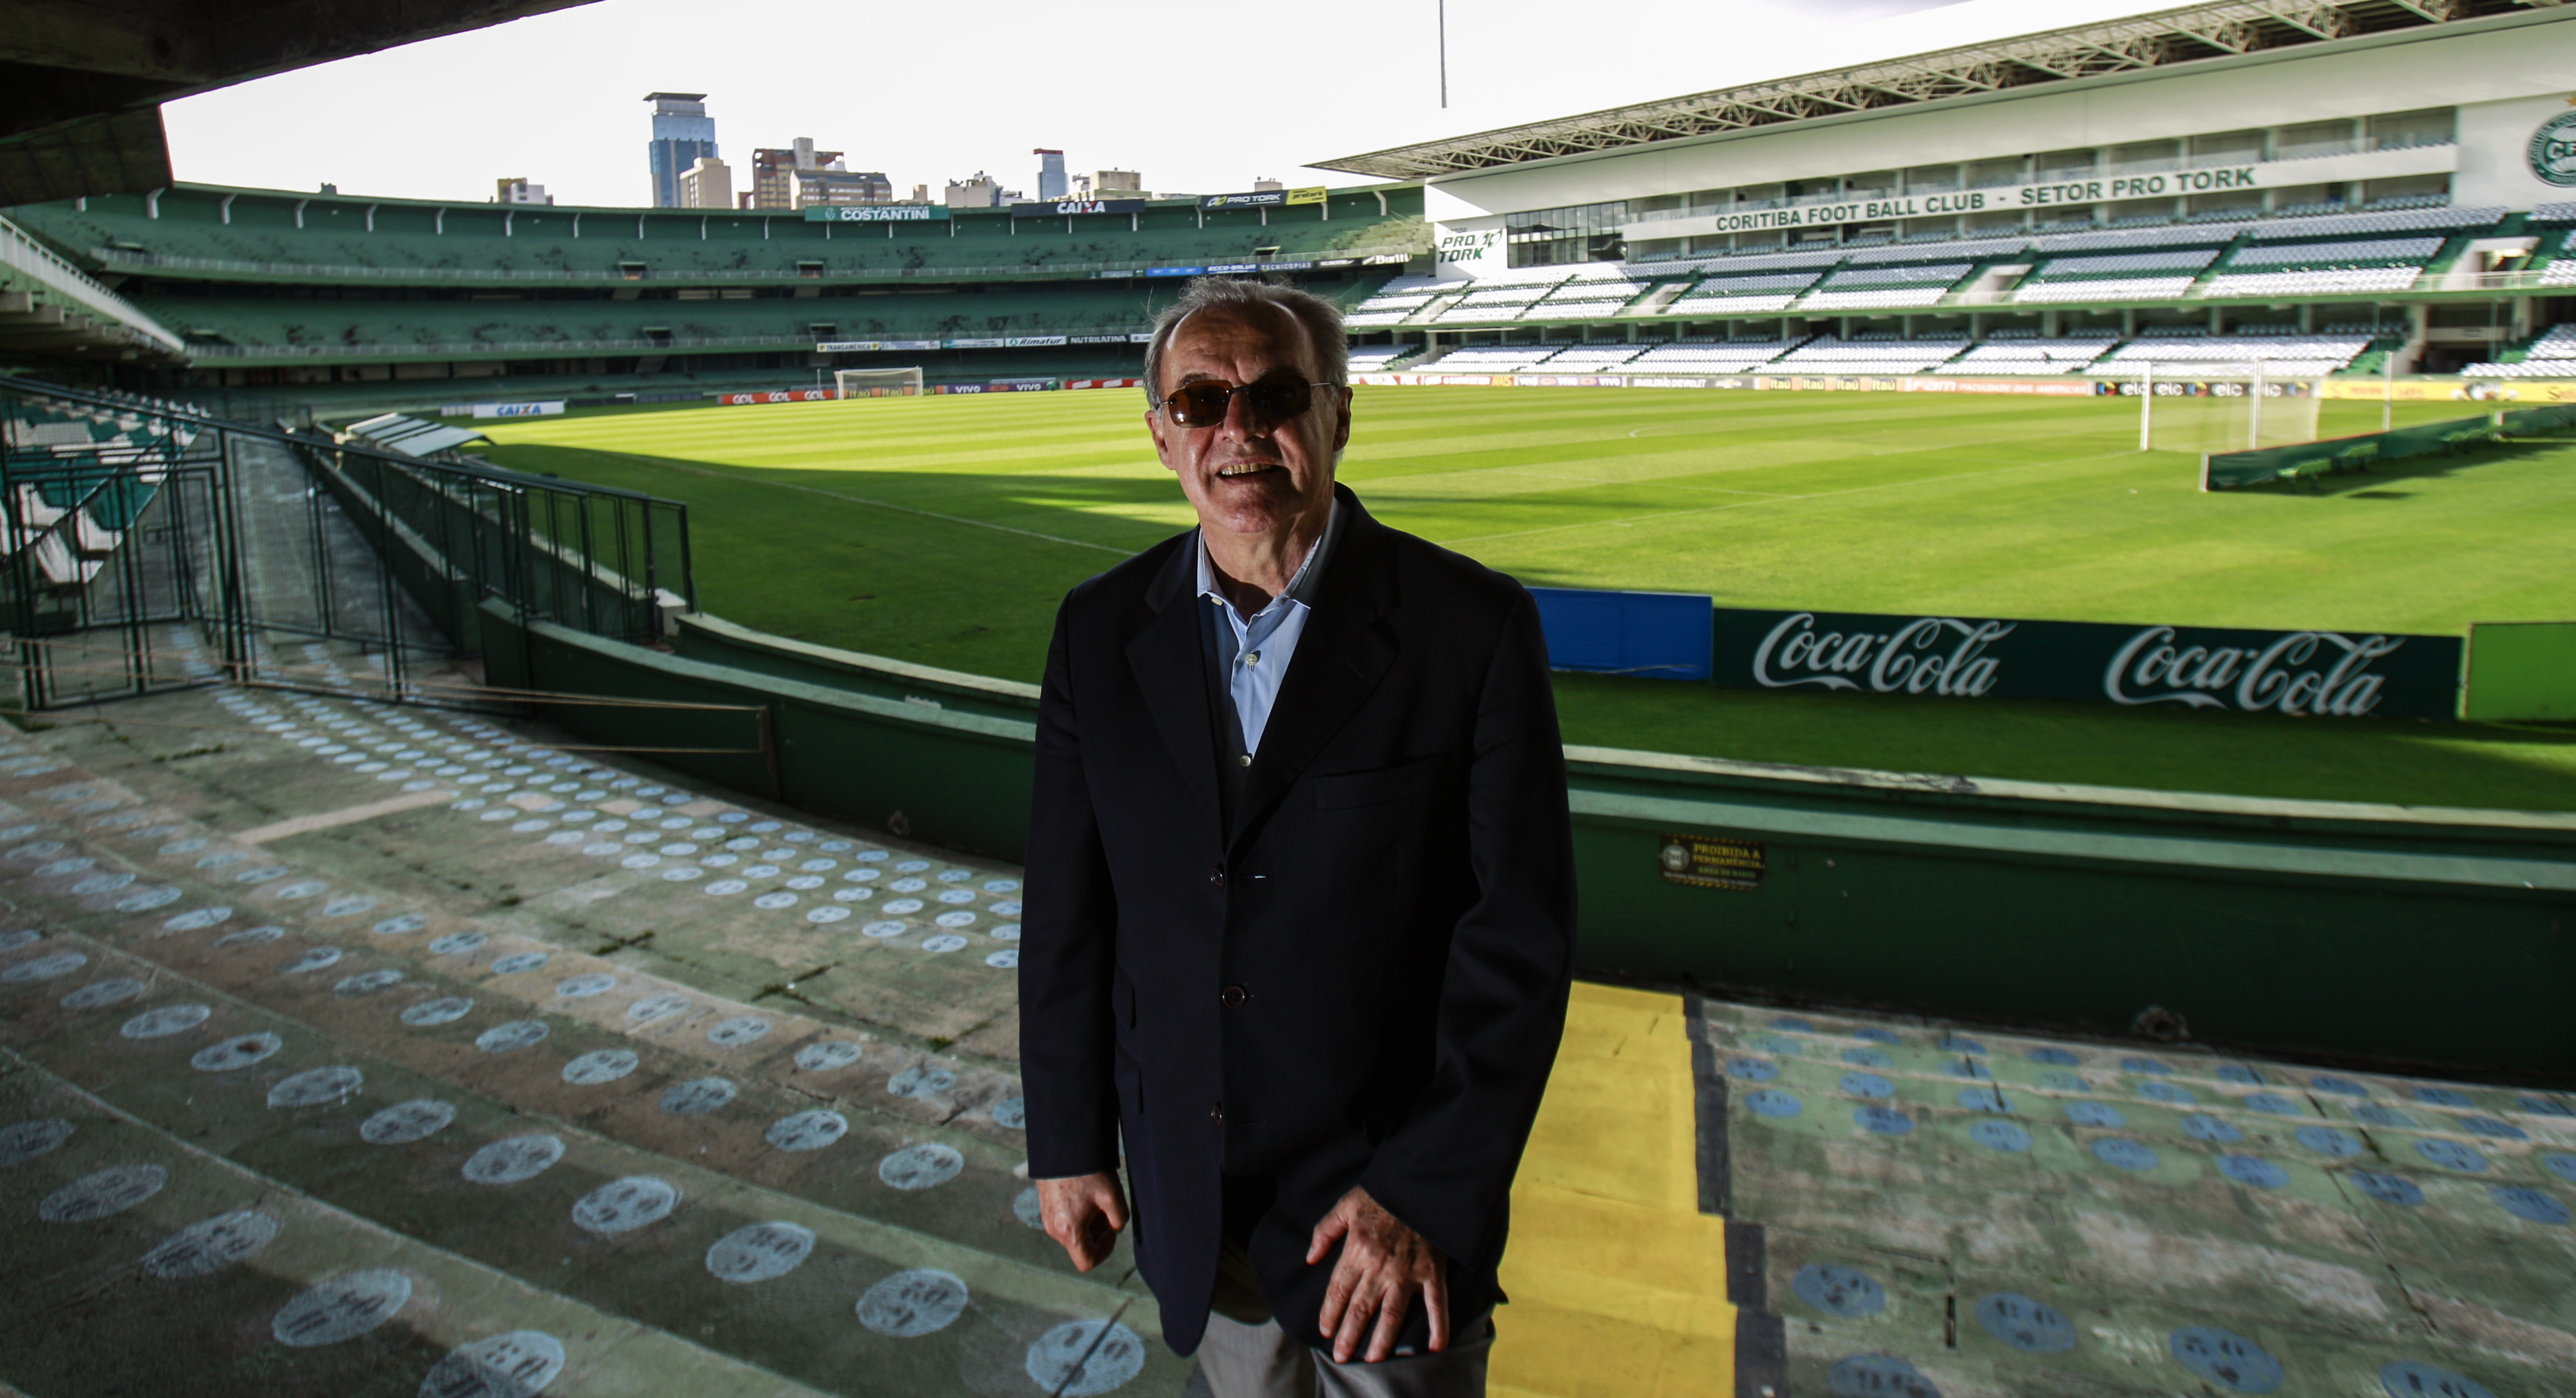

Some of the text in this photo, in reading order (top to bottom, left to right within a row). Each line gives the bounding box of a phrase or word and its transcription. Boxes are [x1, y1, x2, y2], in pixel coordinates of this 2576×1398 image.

[1251, 194, 1281, 202] TORK
[1717, 209, 1802, 231] CORITIBA
[1808, 204, 1860, 223] FOOT
[1867, 199, 1919, 218] BALL
[1926, 193, 1985, 211] CLUB
[2021, 181, 2103, 205] SETOR
[2112, 175, 2167, 197] PRO
[2177, 167, 2256, 191] TORK
[1057, 201, 1105, 214] CAIXA
[840, 209, 929, 221] COSTANTINI
[1442, 235, 1476, 248] PRO
[1440, 247, 1484, 263] TORK
[1261, 262, 1311, 270] TECNICOPIAS
[1019, 338, 1062, 346] Rimatur
[1071, 335, 1127, 344] NUTRILATINA
[1671, 379, 1707, 388] CHEVROLET
[1770, 379, 1791, 389] Itaú
[1803, 379, 1824, 390] Itaú
[1836, 380, 1859, 390] Itaú
[1872, 380, 1895, 390] Itaú
[2014, 384, 2034, 393] DAS
[769, 392, 791, 402] GOL
[804, 390, 826, 401] GOL
[850, 388, 871, 398] Itaú
[882, 388, 903, 397] Itaú
[733, 394, 755, 404] GOL
[496, 404, 541, 417] CAIXA
[1753, 613, 2018, 697] Coca-Cola
[2105, 625, 2406, 716] Coca-Cola
[1693, 843, 1750, 858] PROIBIDA
[1752, 849, 1761, 860] A
